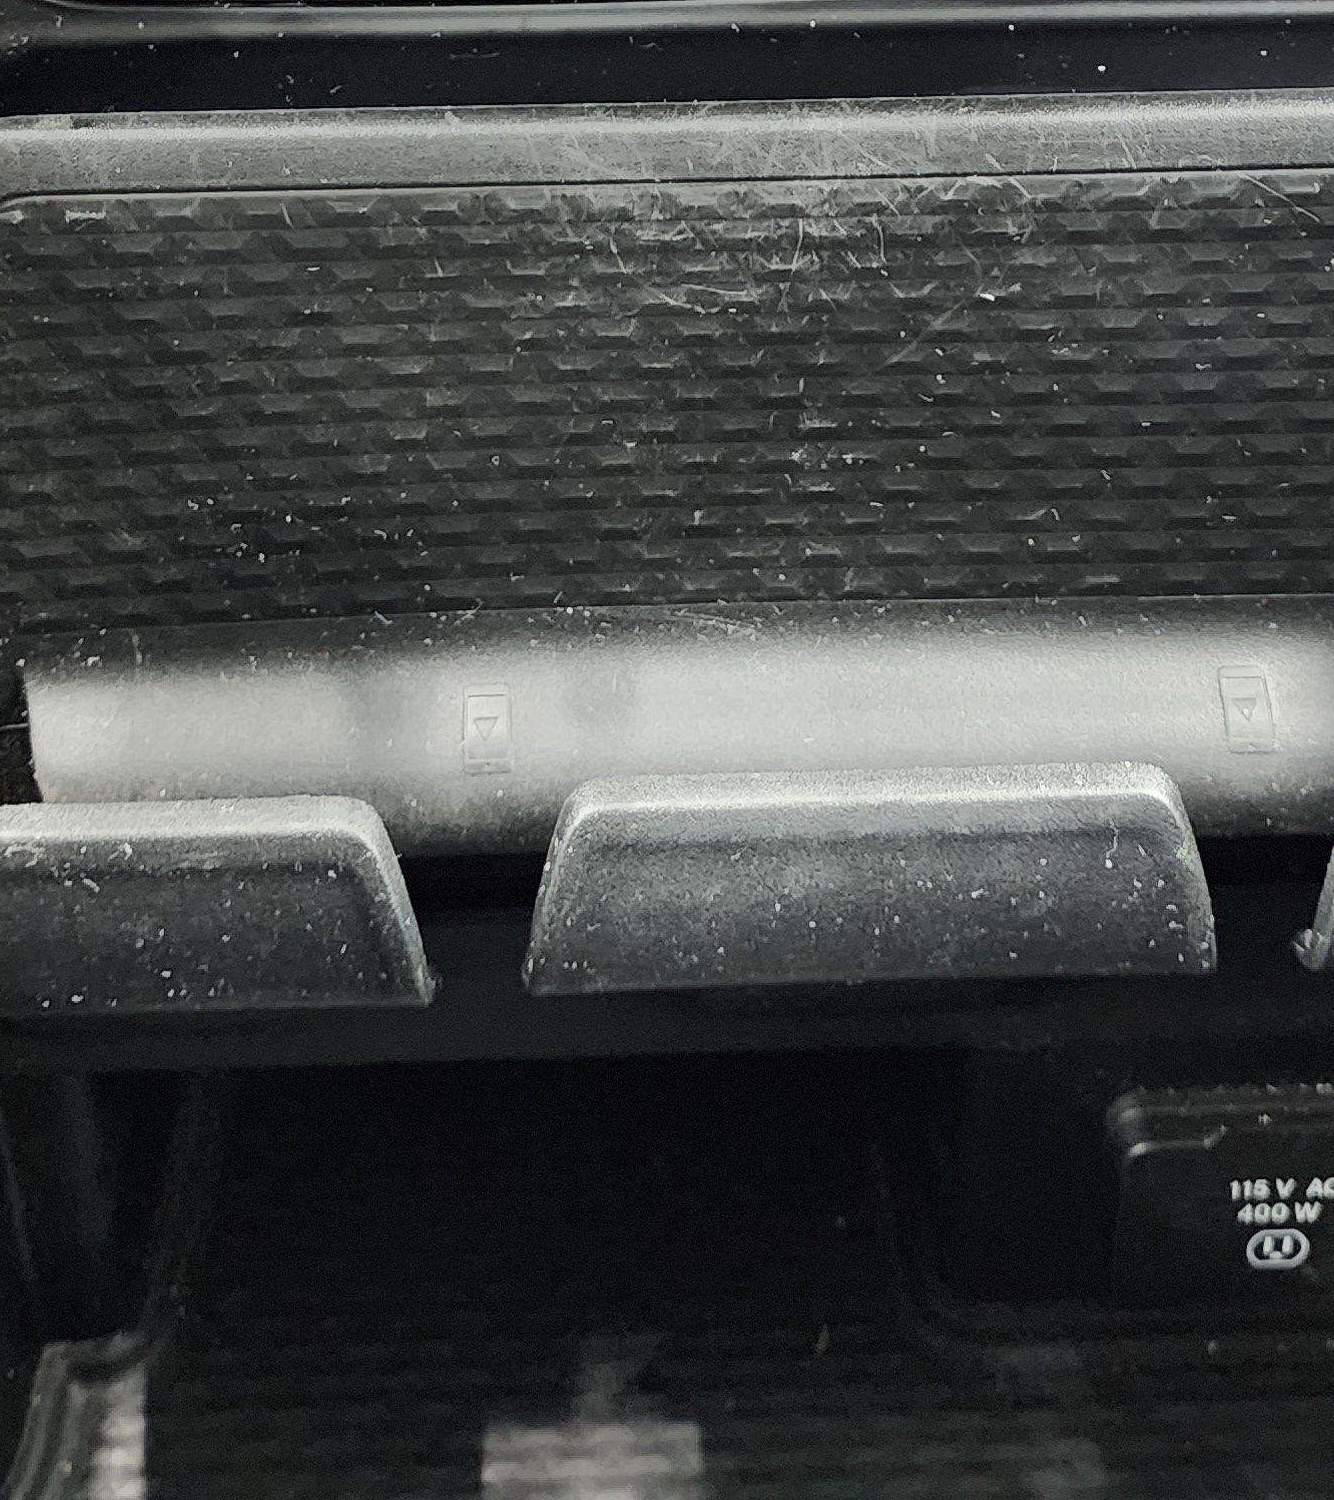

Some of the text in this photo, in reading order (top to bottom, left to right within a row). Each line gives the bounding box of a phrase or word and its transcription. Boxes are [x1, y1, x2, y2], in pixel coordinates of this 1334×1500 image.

[1229, 1178, 1271, 1201] 115
[1275, 1177, 1298, 1200] V
[1237, 1201, 1322, 1225] 400 W
